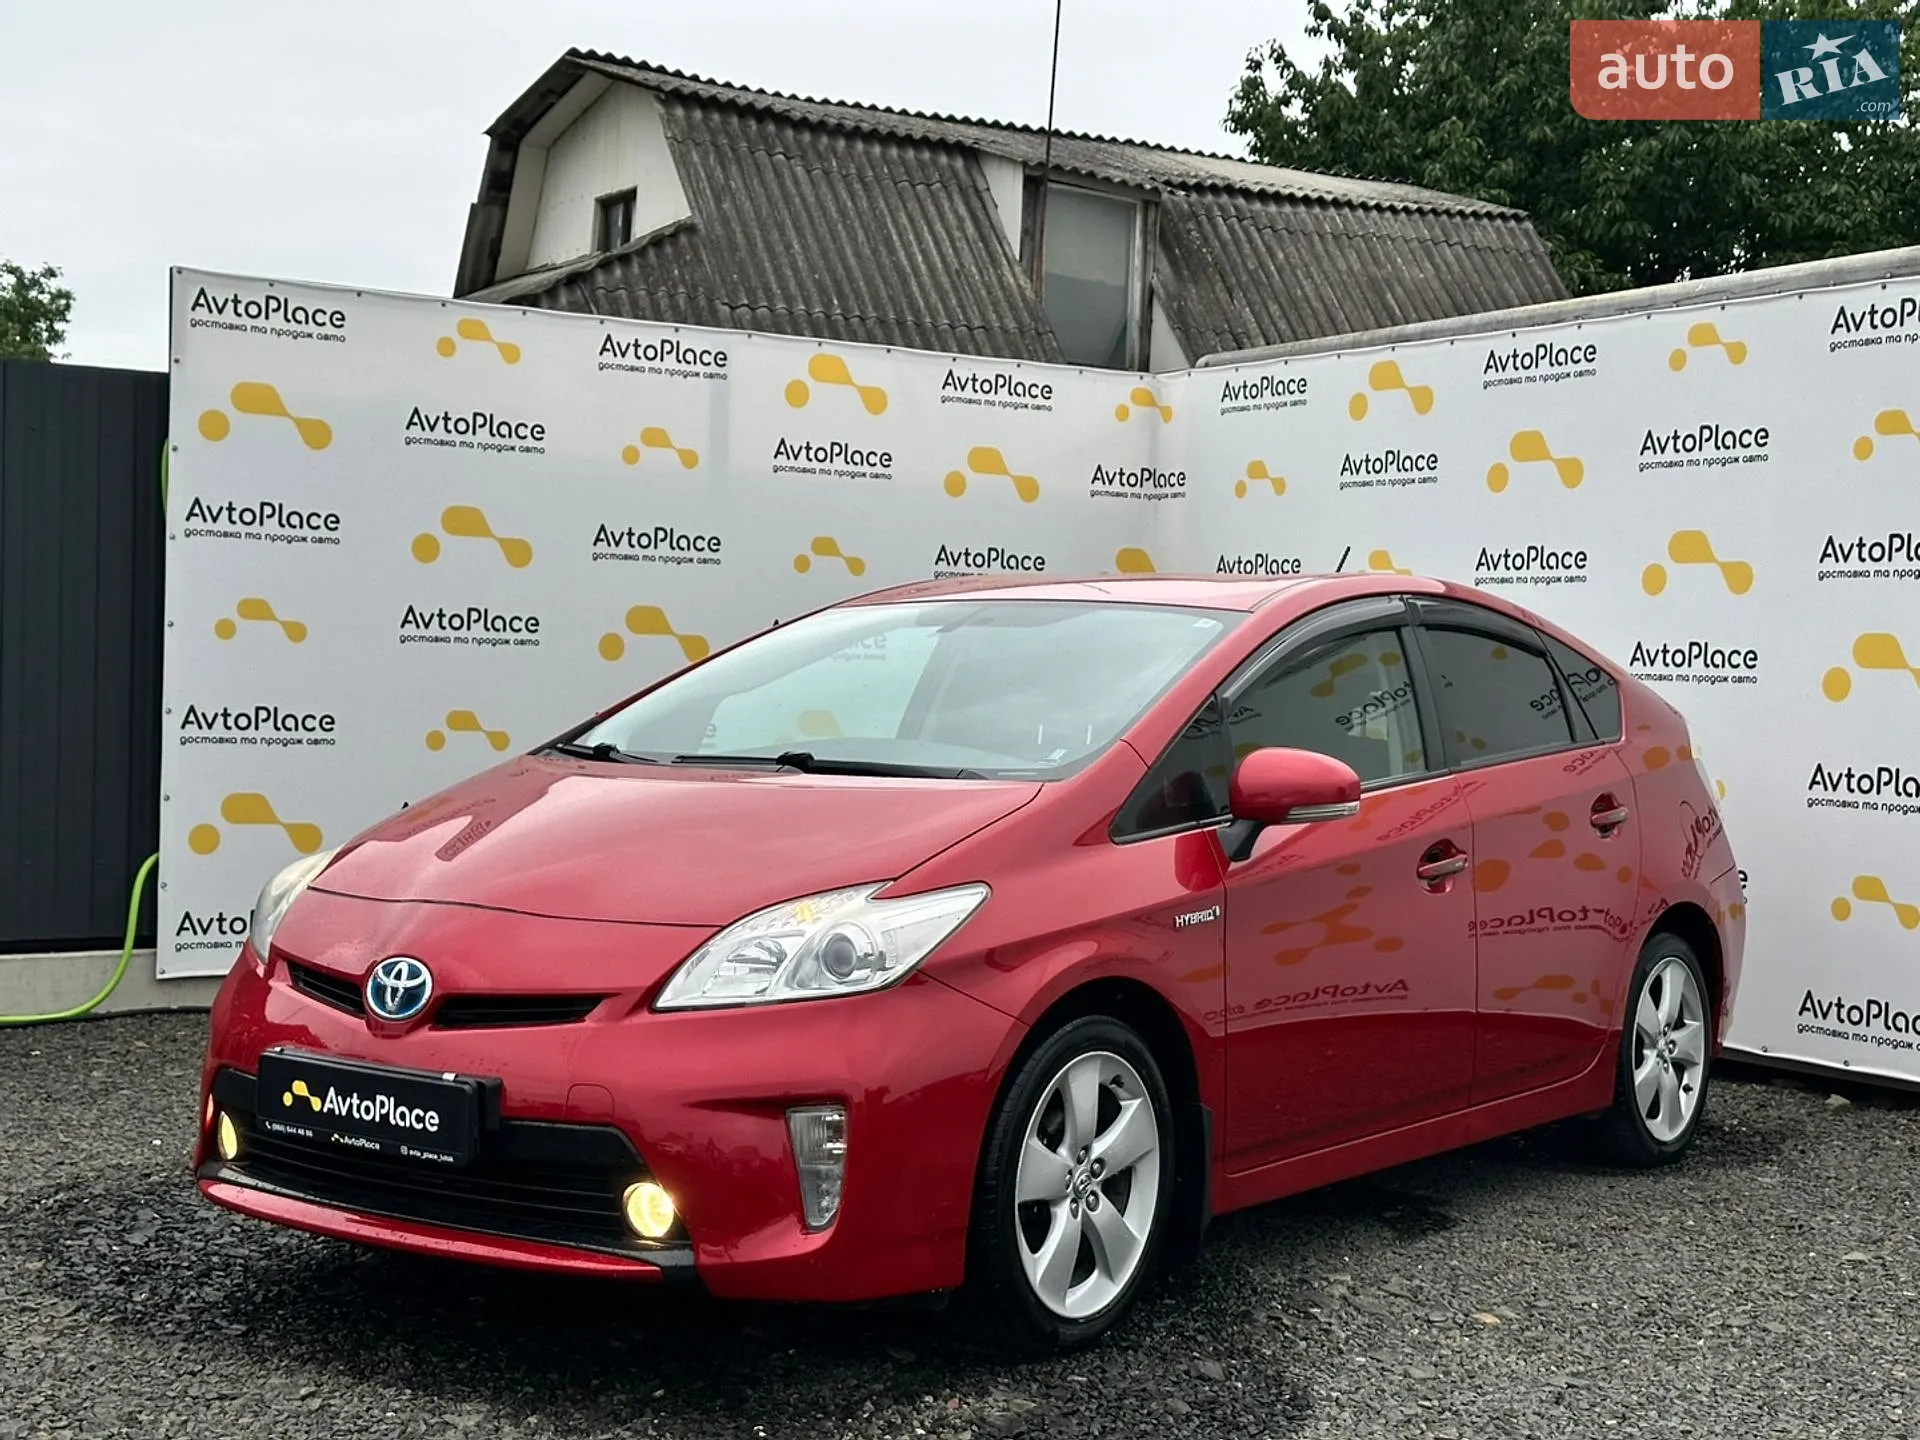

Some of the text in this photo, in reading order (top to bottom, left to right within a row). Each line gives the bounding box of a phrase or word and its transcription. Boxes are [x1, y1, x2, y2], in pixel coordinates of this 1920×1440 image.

[190, 286, 347, 329] AvtoPlace
[598, 333, 729, 369] AvtoPlace
[1483, 341, 1598, 375] AvtoPlace
[941, 368, 1053, 401] AvtoPlace
[1220, 374, 1308, 403] AvtoPlace
[405, 405, 546, 442] AvtoPlace
[773, 437, 893, 469] AvtoPlace
[1639, 423, 1770, 457] AvtoPlace
[1090, 463, 1187, 490] AvtoPlace
[1339, 449, 1439, 477] AvtoPlace
[185, 496, 341, 532] AvtoPlace
[592, 523, 722, 554] AvtoPlace
[934, 543, 1046, 572] AvtoPlace
[1215, 552, 1301, 576] AvtoPlace
[1475, 544, 1588, 573] AvtoPlace
[399, 604, 541, 635] AvtoPlace
[1629, 640, 1759, 670] AvtoPlace
[179, 703, 336, 733] AvtoPlace
[175, 909, 255, 937] Avto
[1174, 908, 1215, 928] HYBRID
[322, 1085, 440, 1133] AvtoPlace
